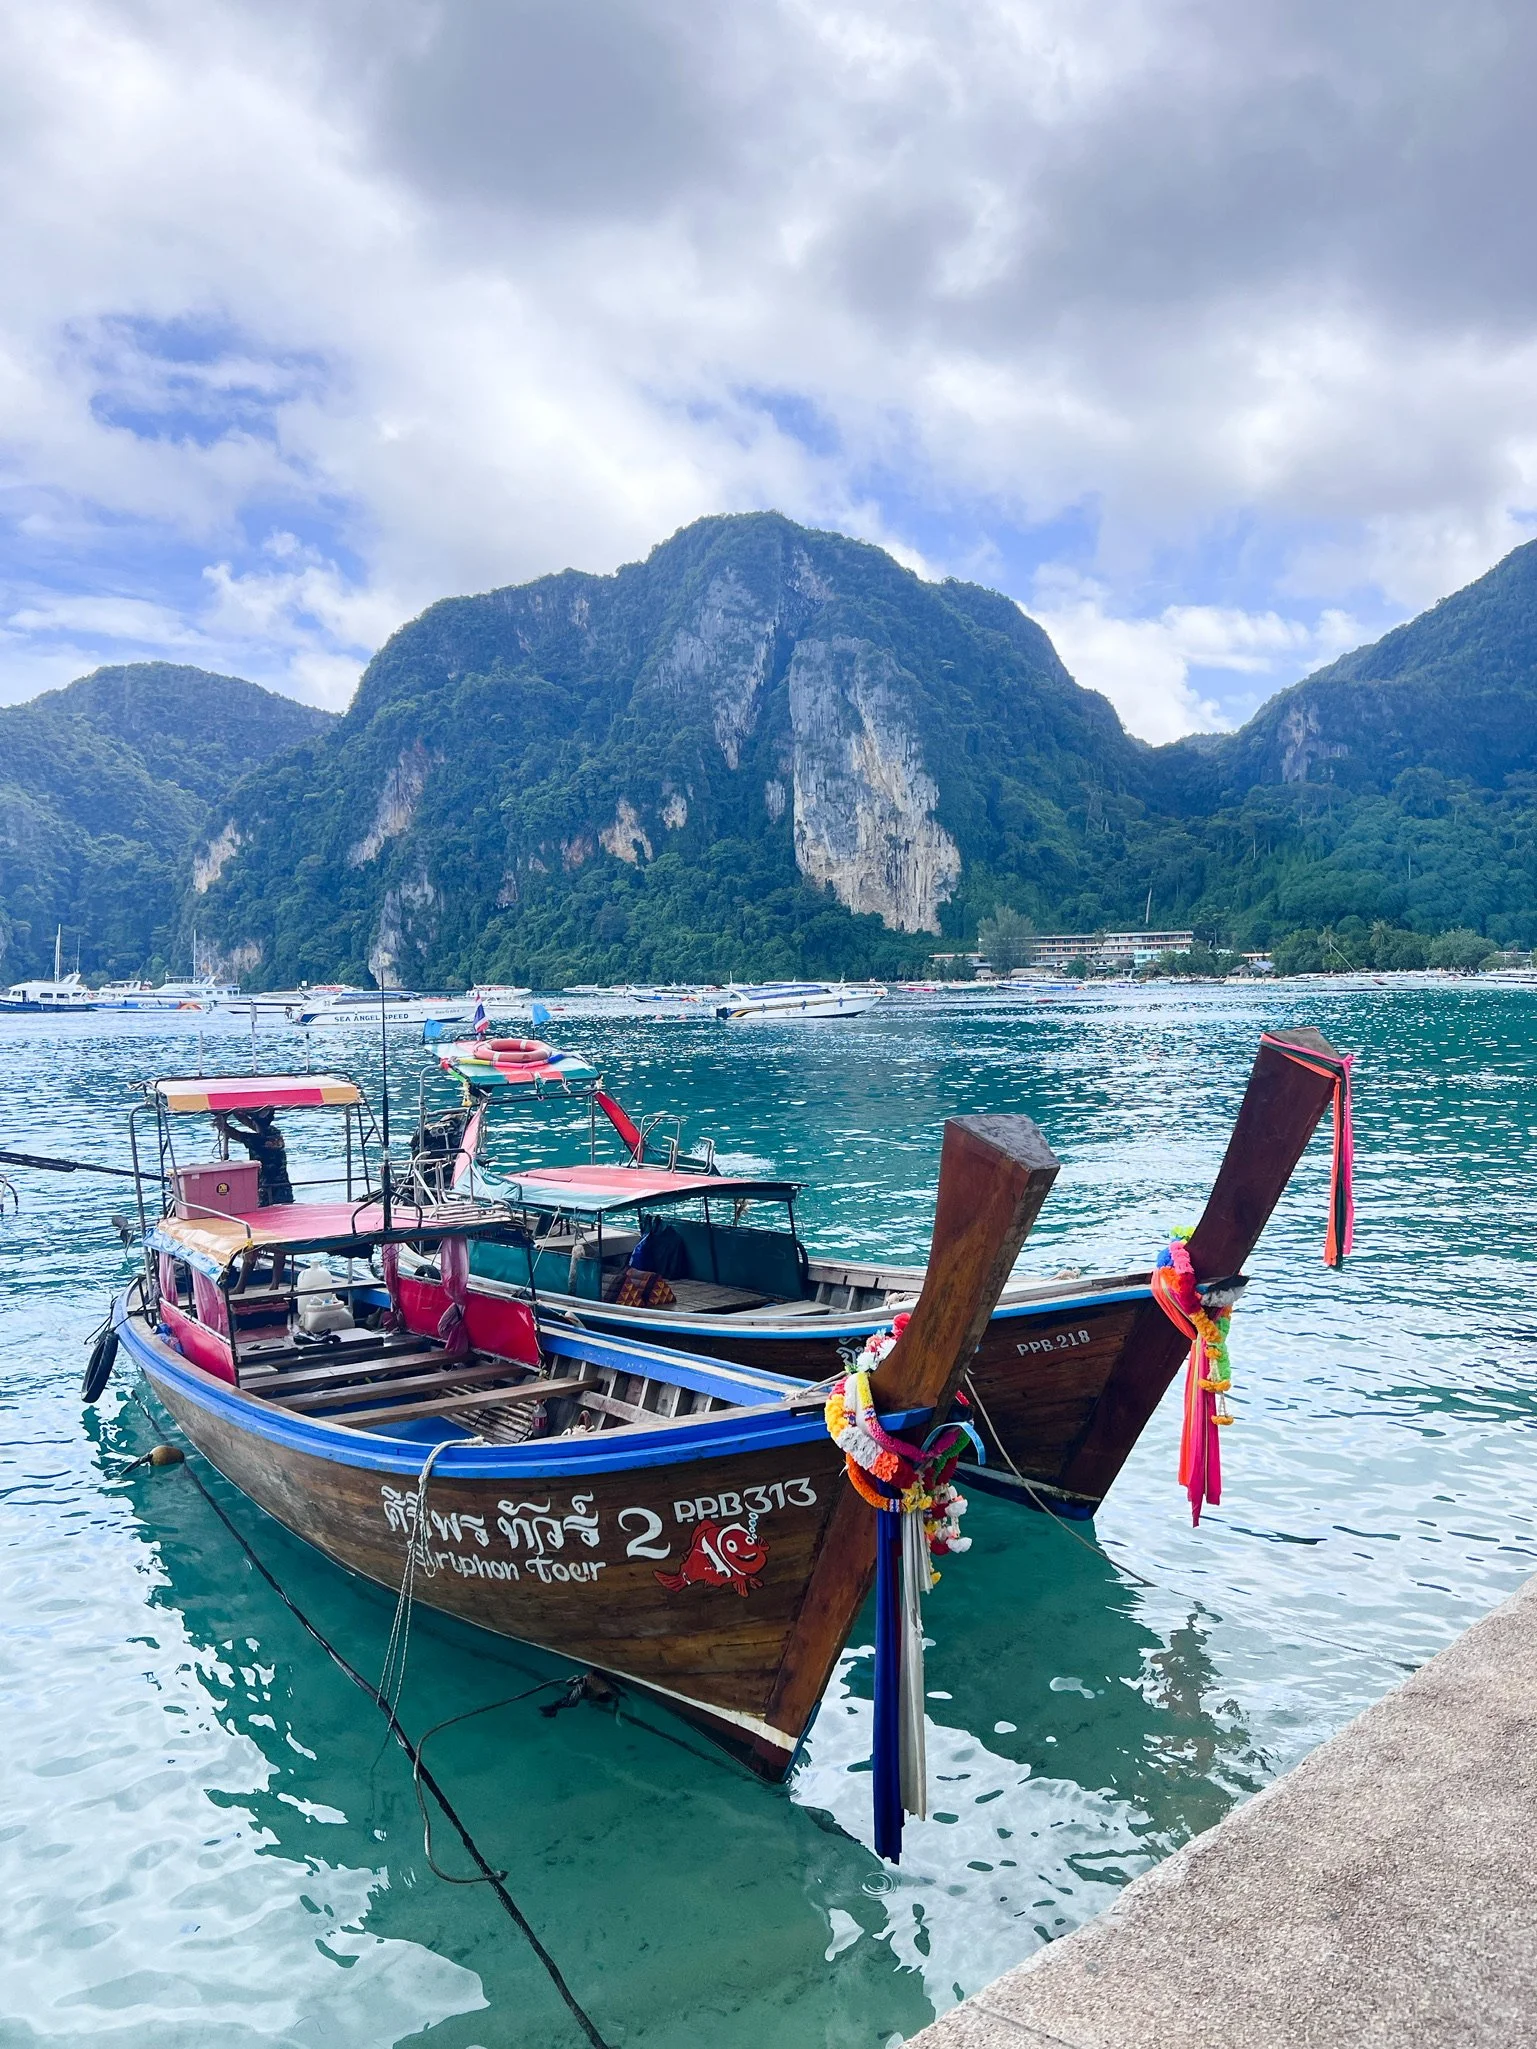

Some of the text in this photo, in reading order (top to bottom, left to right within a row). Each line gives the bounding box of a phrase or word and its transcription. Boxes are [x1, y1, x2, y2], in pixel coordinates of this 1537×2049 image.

[354, 1014, 381, 1022] ANGEL
[383, 1013, 409, 1021] SPEED
[617, 1506, 671, 1561] 2
